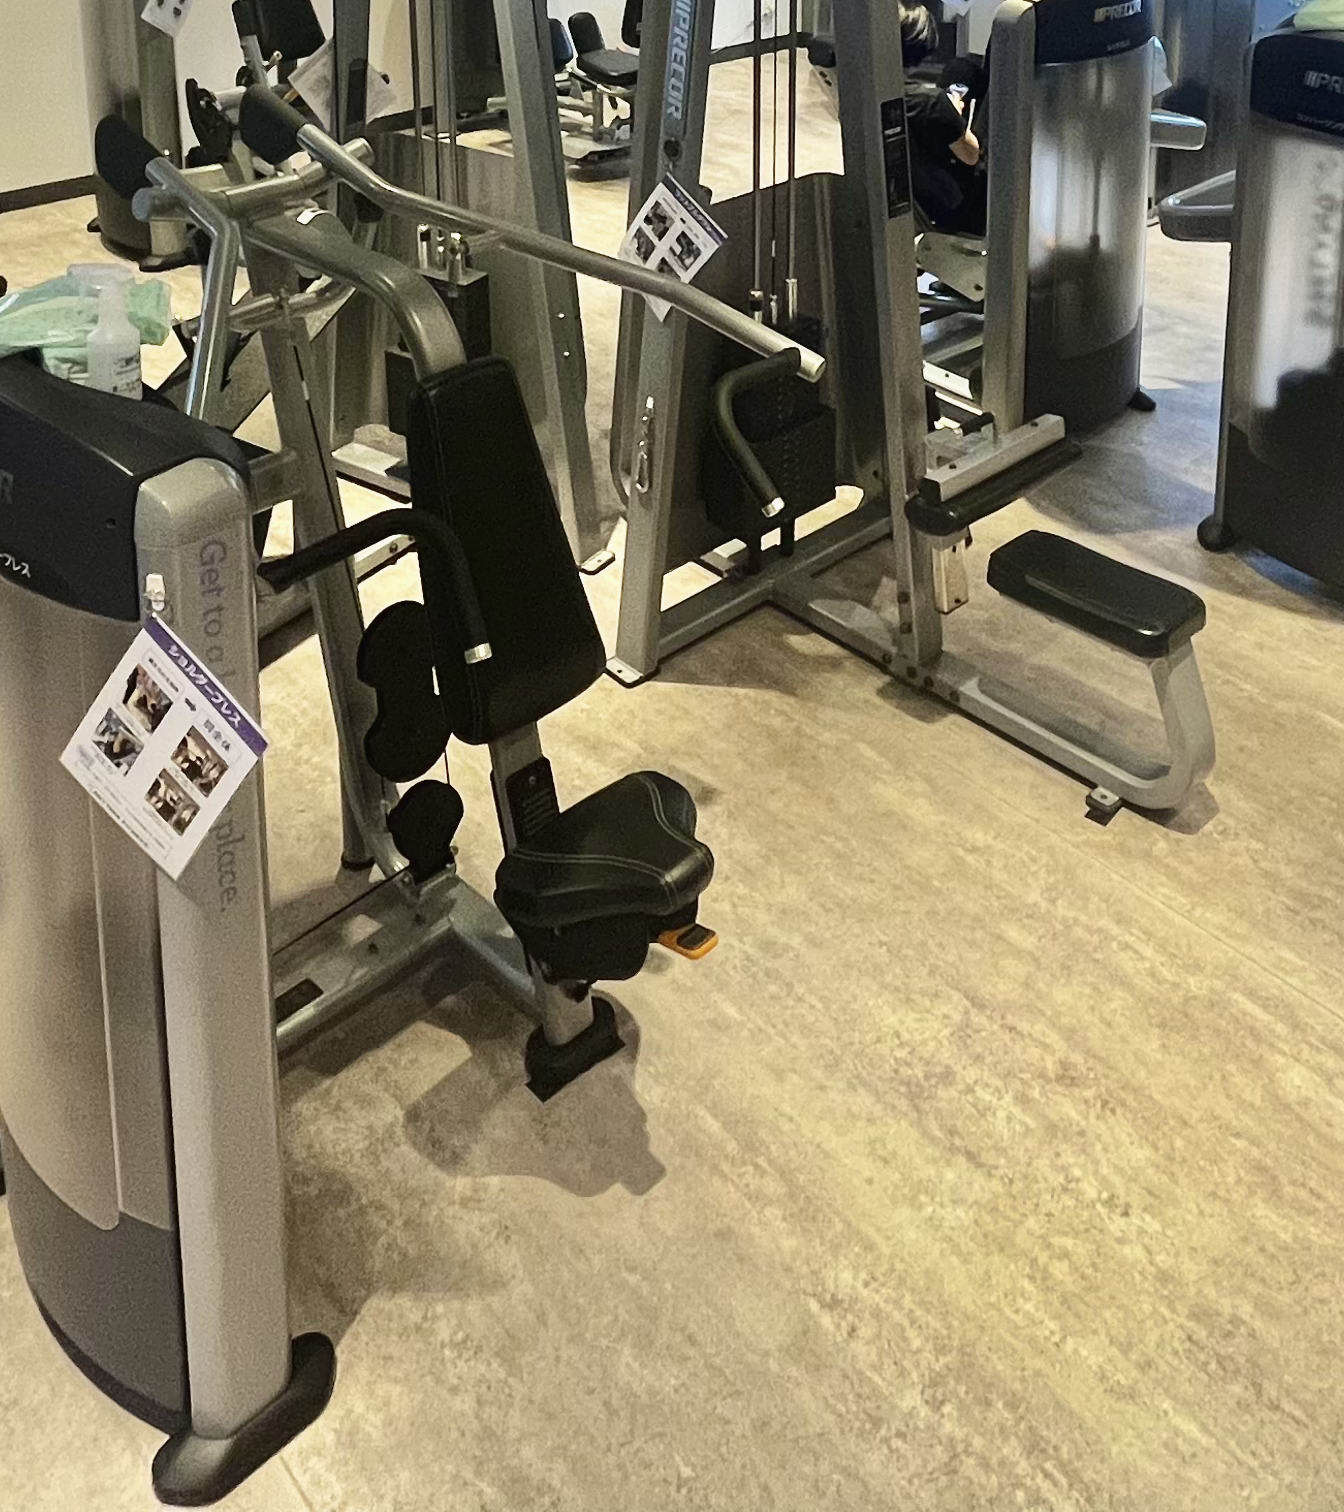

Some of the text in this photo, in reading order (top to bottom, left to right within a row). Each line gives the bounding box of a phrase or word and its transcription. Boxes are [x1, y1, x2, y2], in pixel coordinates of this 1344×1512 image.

[666, 4, 692, 121] PRECOR
[199, 540, 246, 913] Get to a place.
